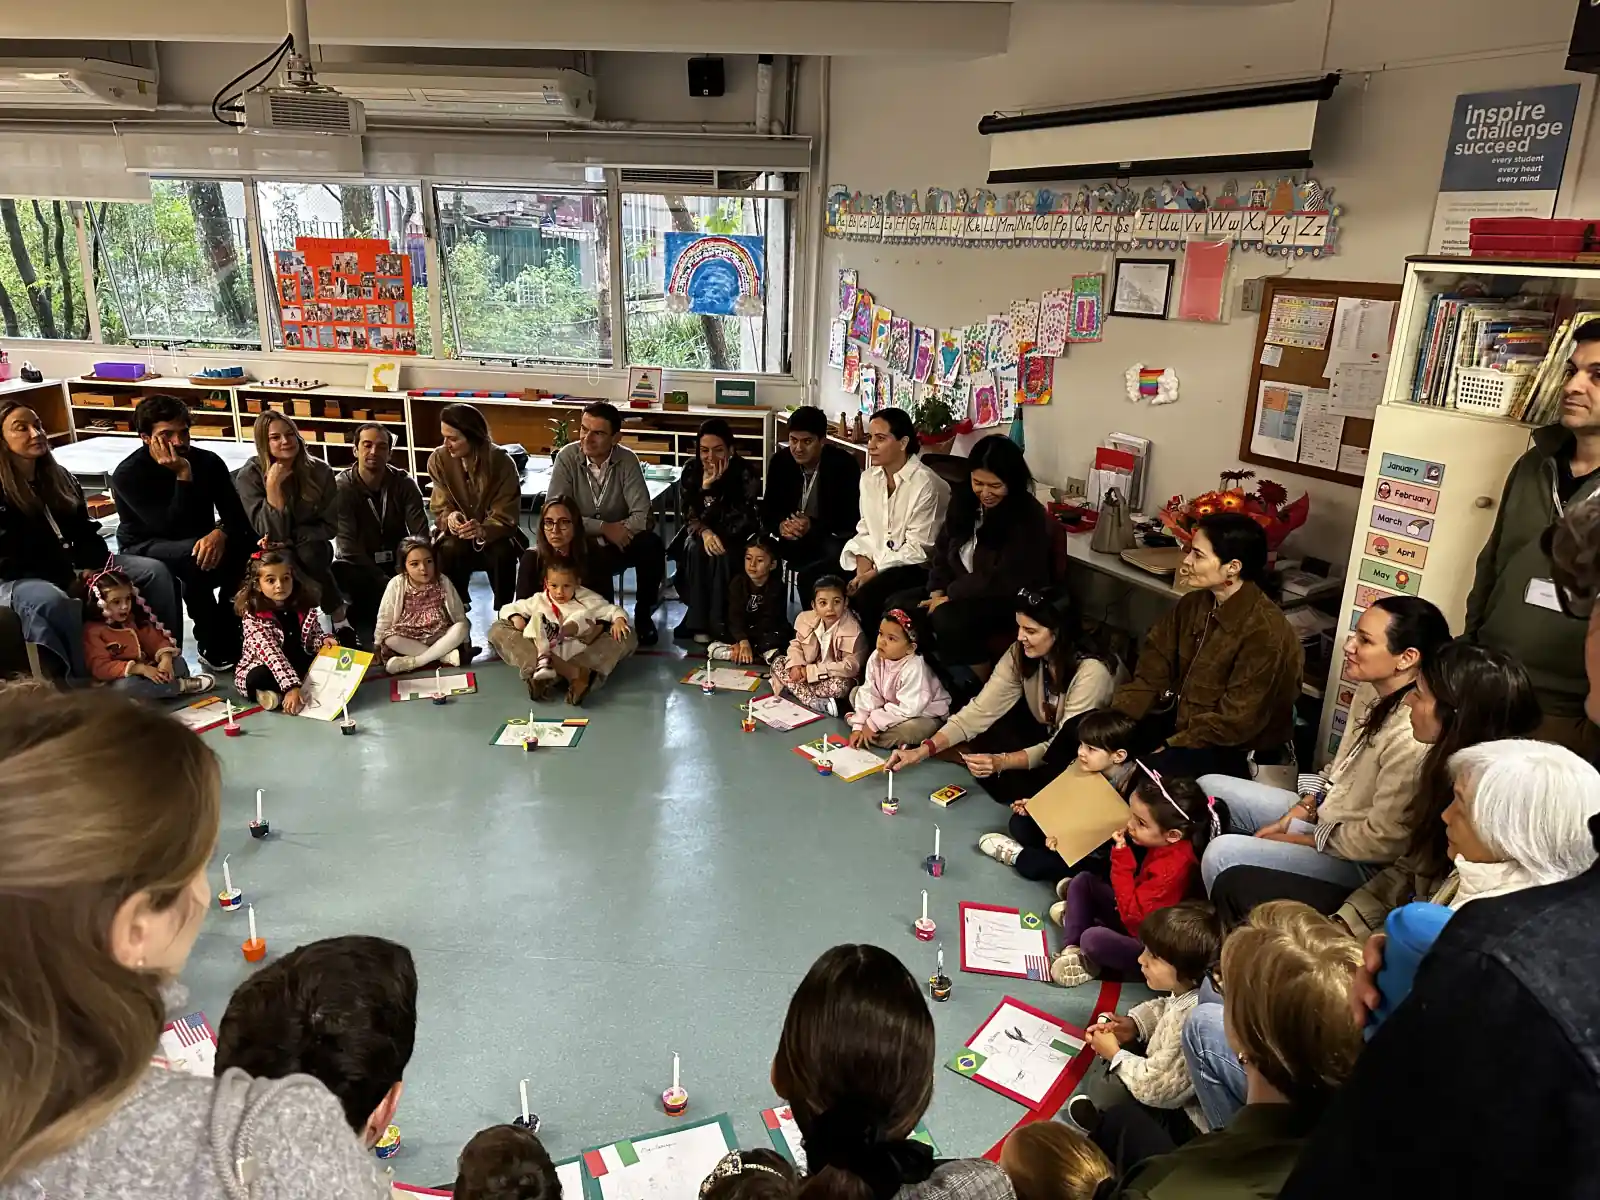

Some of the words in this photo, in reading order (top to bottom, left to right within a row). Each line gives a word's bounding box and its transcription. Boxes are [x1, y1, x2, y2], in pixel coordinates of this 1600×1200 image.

[1465, 101, 1546, 126] inspire
[1466, 121, 1563, 140] challenge
[1454, 136, 1531, 155] succeed
[1491, 156, 1513, 165] every
[1514, 155, 1545, 163] student
[1498, 166, 1520, 174] every
[1520, 165, 1542, 173] heart
[1496, 176, 1518, 184] every
[1519, 175, 1541, 183] mind
[848, 215, 857, 228] Bb
[859, 215, 867, 228] Cc
[869, 216, 881, 229] Dd
[884, 216, 893, 229] Ee
[895, 216, 906, 230] Ff
[909, 216, 920, 236] Gg
[922, 216, 936, 231] Hh
[939, 216, 947, 230] Ii
[951, 216, 962, 237] Jj
[966, 216, 981, 232] Kk
[984, 216, 994, 232] Ll
[997, 216, 1015, 232] Mm
[1016, 216, 1032, 231] Nn
[1035, 215, 1049, 231] Oo
[1053, 215, 1068, 238] Pp
[1075, 215, 1089, 239] Qq
[1092, 215, 1110, 232] Rr
[1114, 215, 1130, 233] Ss
[1138, 213, 1154, 230] Tt
[1159, 213, 1180, 231] Uu
[1185, 213, 1202, 232] Vv
[1211, 211, 1240, 230] Ww
[1243, 211, 1265, 231] Xx
[1266, 215, 1290, 245] Yy
[1298, 215, 1325, 237] Zz
[1387, 461, 1419, 476] January
[1394, 489, 1432, 505] February
[1377, 513, 1403, 526] March
[1396, 547, 1416, 558] April
[1373, 568, 1390, 580] May
